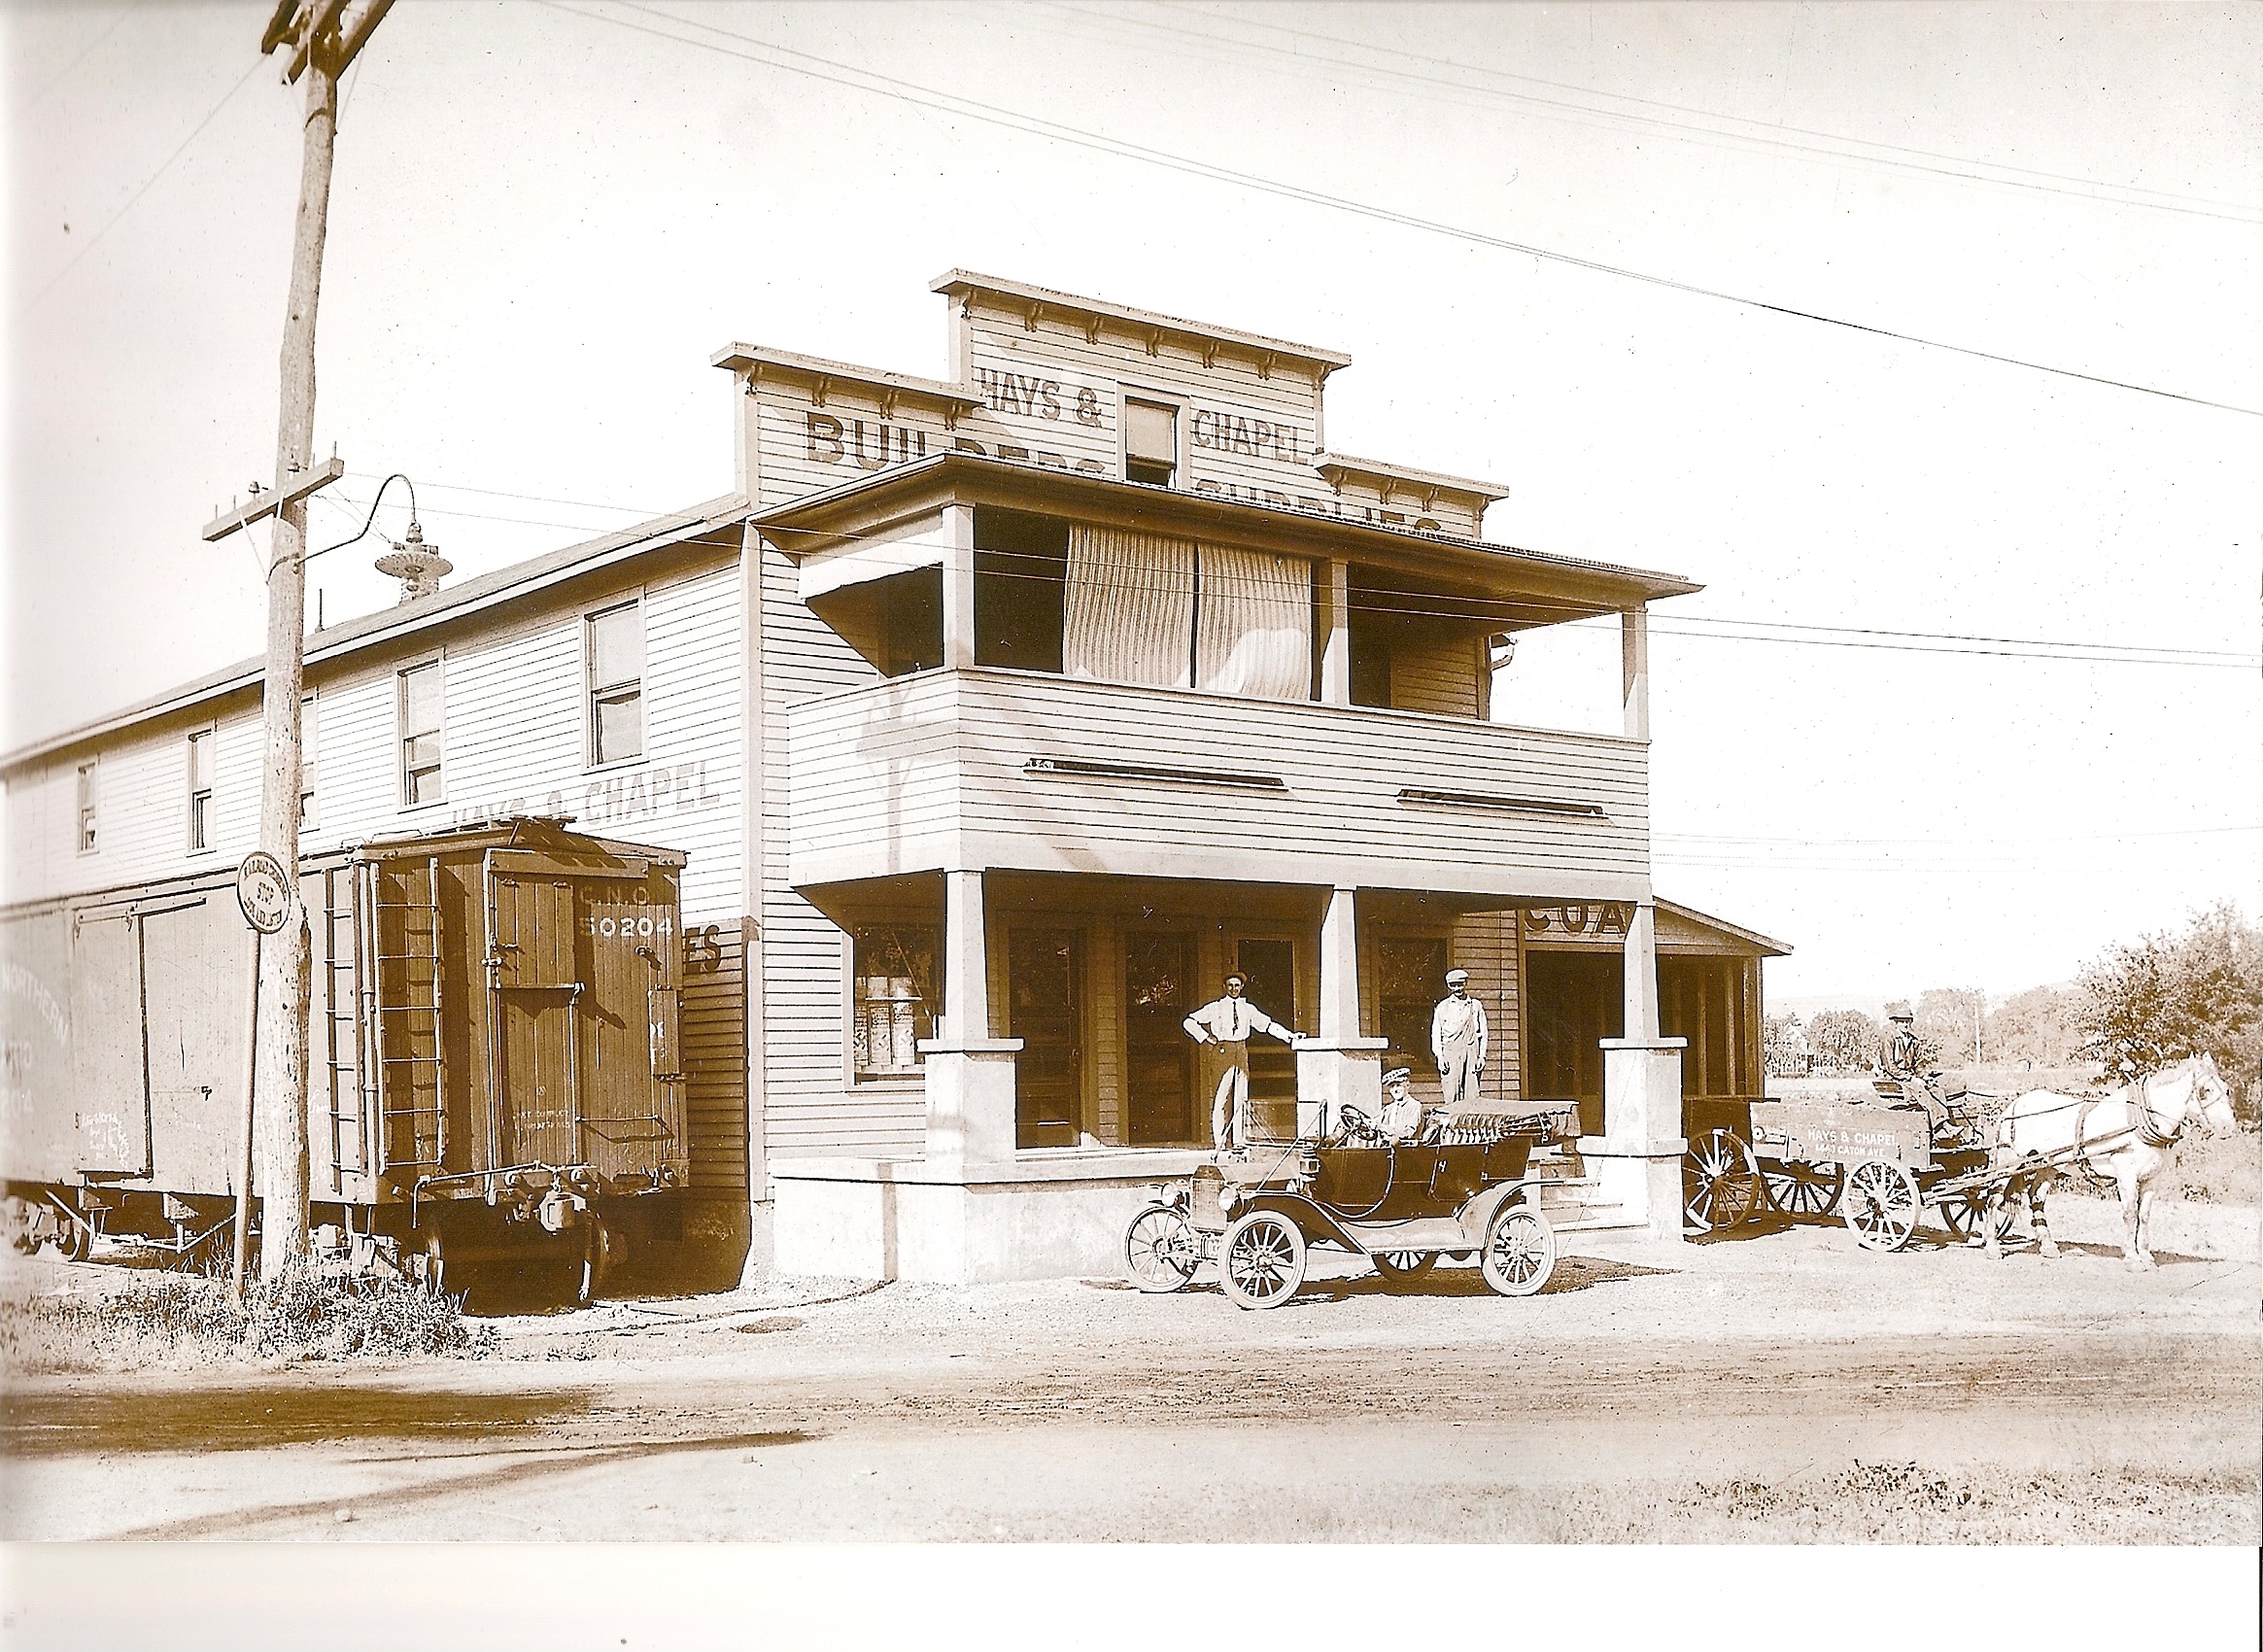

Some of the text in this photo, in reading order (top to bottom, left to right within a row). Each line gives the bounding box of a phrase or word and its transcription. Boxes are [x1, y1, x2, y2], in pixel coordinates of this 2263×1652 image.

[980, 367, 1309, 465] HAYS & CHAPEL
[585, 760, 721, 826] CHAPEL
[1807, 1129, 1898, 1146] HAYS & CHAPEL
